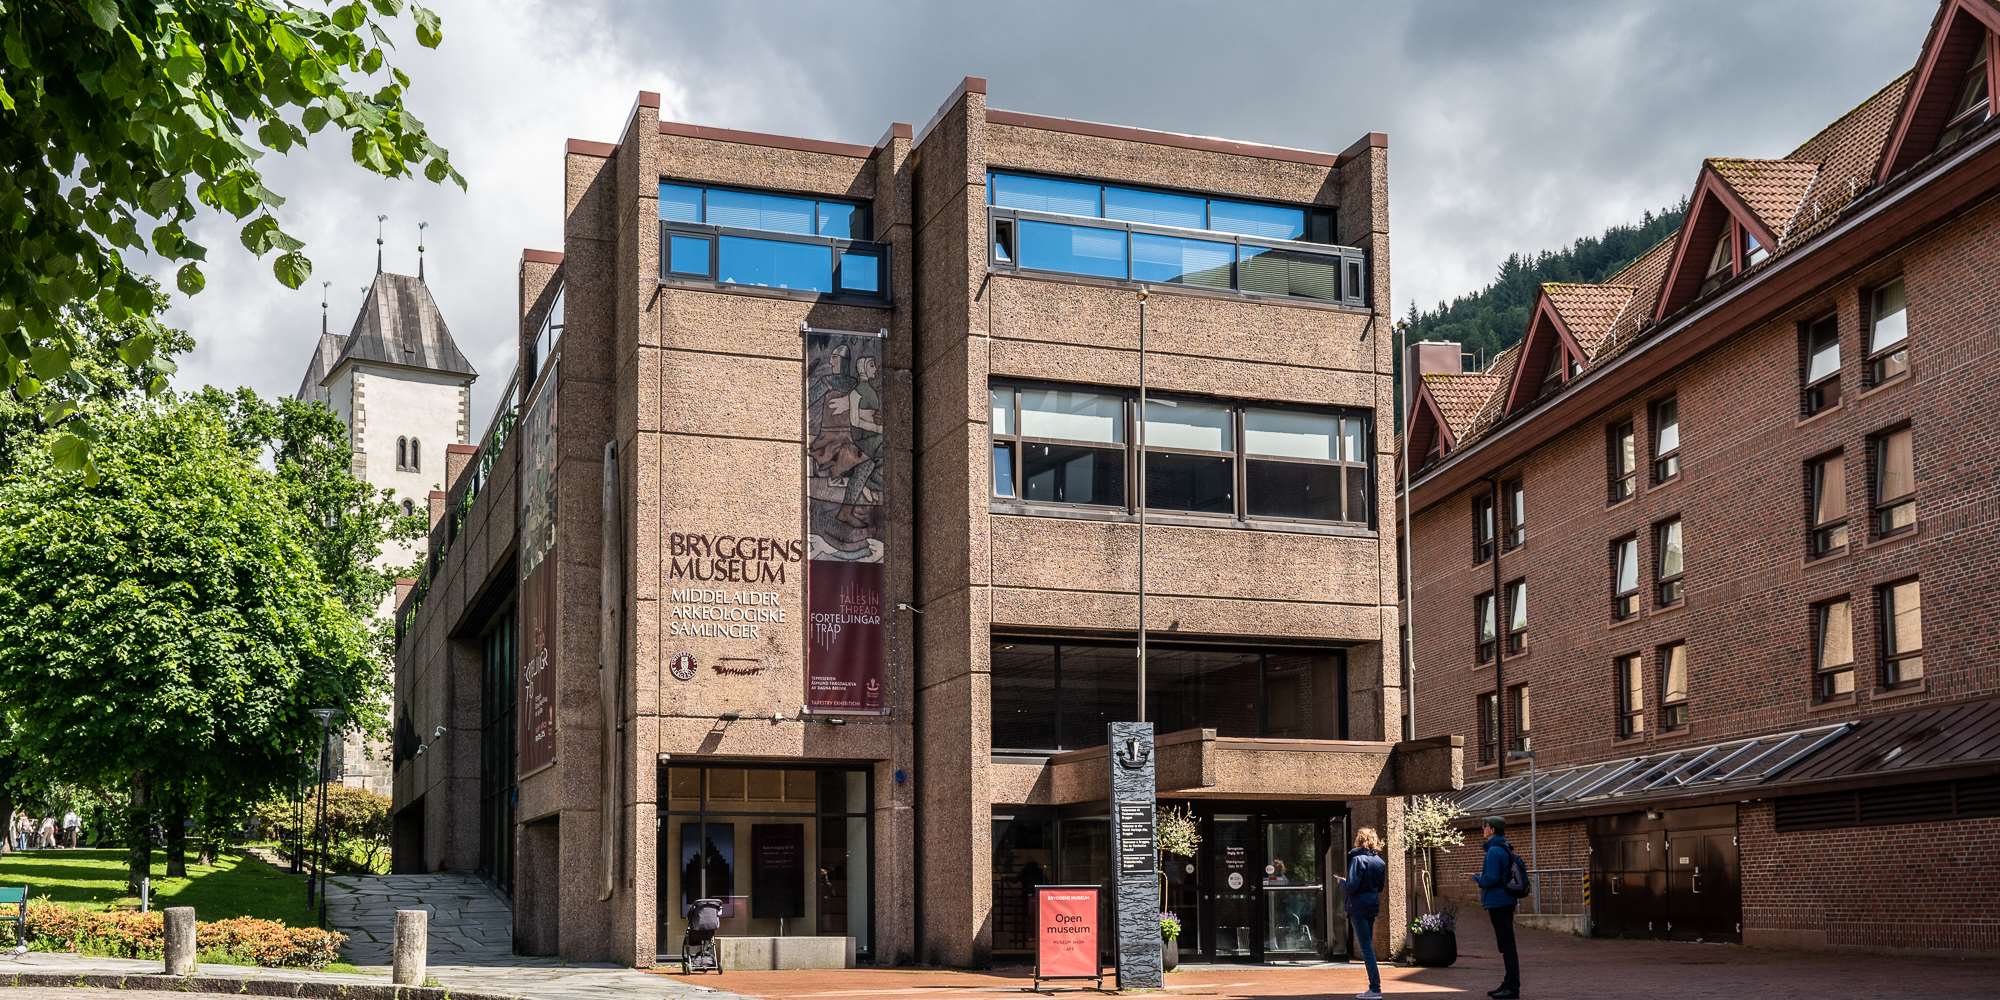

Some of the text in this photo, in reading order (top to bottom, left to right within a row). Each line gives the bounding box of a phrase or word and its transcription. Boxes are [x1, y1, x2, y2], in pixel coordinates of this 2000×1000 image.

[670, 532, 803, 562] BRYGGENS
[669, 557, 786, 584] MUSEUM
[670, 588, 780, 606] MIDDELALDER
[840, 589, 866, 605] TALES
[671, 605, 786, 623] ARKEOLOGISKE
[840, 604, 877, 615] THREAD
[811, 613, 880, 625] FORTELJINGAR
[670, 621, 759, 640] SAMLINGER
[816, 622, 841, 639] TRÅD
[1055, 913, 1082, 924] Open
[1047, 926, 1091, 934] museum
